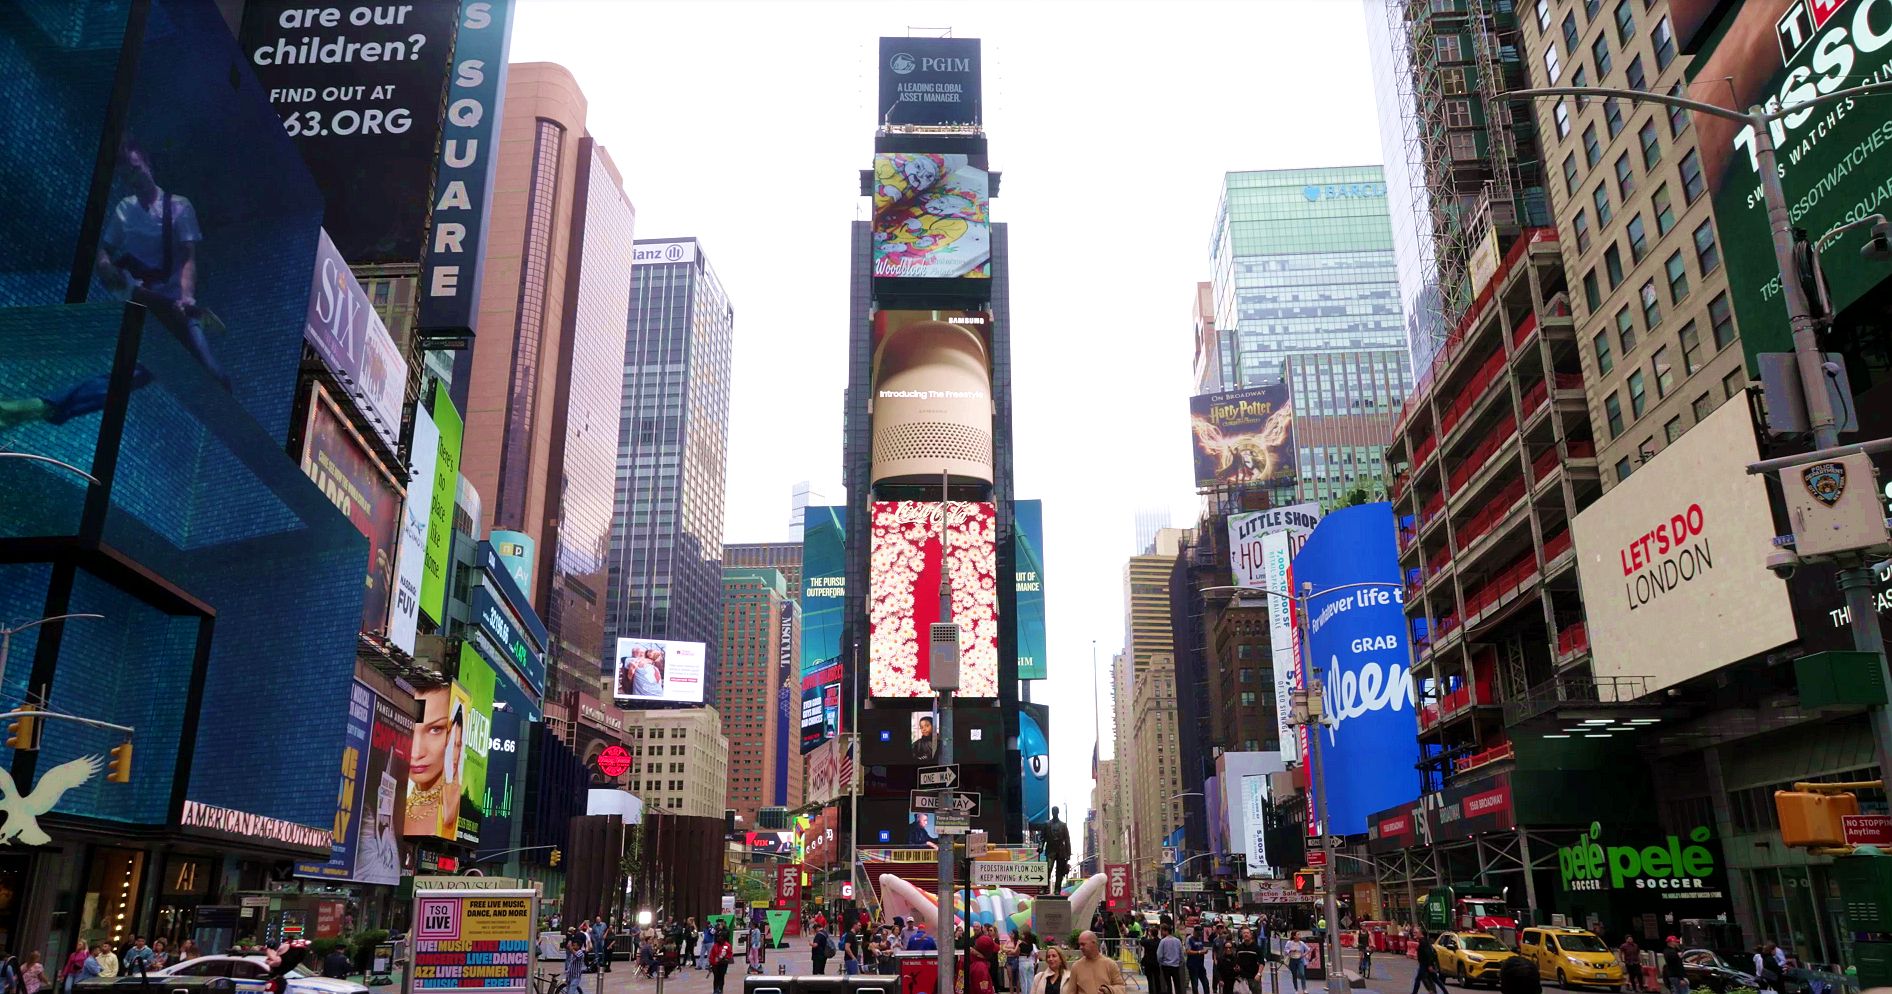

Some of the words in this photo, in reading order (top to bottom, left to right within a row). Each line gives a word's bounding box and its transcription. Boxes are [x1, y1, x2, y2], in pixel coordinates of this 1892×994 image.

[279, 7, 341, 29] are
[349, 5, 413, 26] our
[253, 34, 427, 66] children?
[922, 57, 970, 72] PGIM
[269, 88, 317, 104] FIND
[322, 86, 366, 102] OUT
[370, 85, 396, 100] AT
[897, 83, 903, 91] A
[903, 83, 935, 92] LEADING
[935, 83, 963, 93] GLOBAL
[899, 92, 923, 102] ASSET
[277, 108, 413, 137] 63.ORG
[1788, 96, 1854, 166] WATCHES
[430, 59, 486, 297] SQUARE
[1787, 120, 1892, 225] ISSOTWATCHES
[1325, 183, 1386, 200] BARCL
[632, 249, 662, 260] ianz
[948, 317, 985, 325] SAMSUNG
[879, 389, 928, 400] Introducing
[928, 390, 945, 398] The
[945, 390, 984, 399] Freestyle
[1225, 390, 1266, 400] BROADWAY
[1210, 404, 1240, 425] Harry
[1239, 400, 1272, 419] Potter
[438, 435, 454, 473] There's
[438, 474, 446, 491] no
[431, 494, 446, 523] place
[1239, 511, 1282, 540] LITTLE
[1284, 510, 1318, 530] SHOP
[430, 520, 441, 548] like
[1620, 523, 1670, 577] LET'S
[1670, 503, 1704, 547] DO
[810, 577, 823, 587] THE
[823, 577, 846, 587] PURSUI
[1026, 572, 1036, 582] OF
[1625, 537, 1713, 611] LONDON
[400, 573, 417, 597] NASDAQ
[397, 587, 416, 619] FUV
[1356, 588, 1390, 607] life
[1351, 635, 1398, 654] GRAB
[376, 701, 394, 719] PAMELA
[1280, 702, 1289, 734] SIGNAGE
[923, 774, 935, 784] ONE
[940, 771, 953, 782] WAY
[920, 798, 938, 807] ONE
[1478, 794, 1503, 809] BROADWAY
[184, 800, 251, 836] AMERICAN
[253, 813, 285, 841] EAGLE
[284, 821, 335, 849] OUTFITTERS
[1848, 828, 1881, 837] Anytime
[753, 839, 769, 847] VIX
[1256, 829, 1264, 854] 5,800
[1558, 821, 1605, 891] pelé
[1607, 825, 1714, 889] pelé
[980, 864, 1014, 874] PEDESTRIAN
[1014, 864, 1029, 873] FLOW
[1030, 864, 1045, 873] ZONE
[414, 880, 498, 890] SWAROVSKI
[782, 866, 798, 897] tkts
[980, 874, 995, 882] KEEP
[995, 874, 1016, 882] MOVING
[1110, 866, 1126, 897] tkts
[1571, 879, 1601, 892] SOCCER
[1636, 878, 1703, 889] SOCCER
[430, 905, 448, 916] TSQ
[470, 900, 486, 908] FREE
[487, 900, 502, 908] LIVE
[502, 900, 526, 909] MUSIC,
[467, 909, 492, 918] DANCE,
[492, 909, 507, 917] AND
[508, 909, 528, 917] MORE
[425, 916, 451, 930] LIVE
[416, 940, 438, 952] IVE!
[437, 940, 472, 952] MUSIC
[498, 940, 528, 952] AUDI
[466, 953, 493, 965] LIVE!
[492, 953, 529, 965] DANCE
[415, 965, 436, 978] AZZ
[435, 965, 462, 978] LIVE!
[462, 965, 509, 978] SUMMER
[423, 979, 458, 988] MUSIC
[484, 979, 511, 988] FREE
[510, 979, 526, 988] LIV
